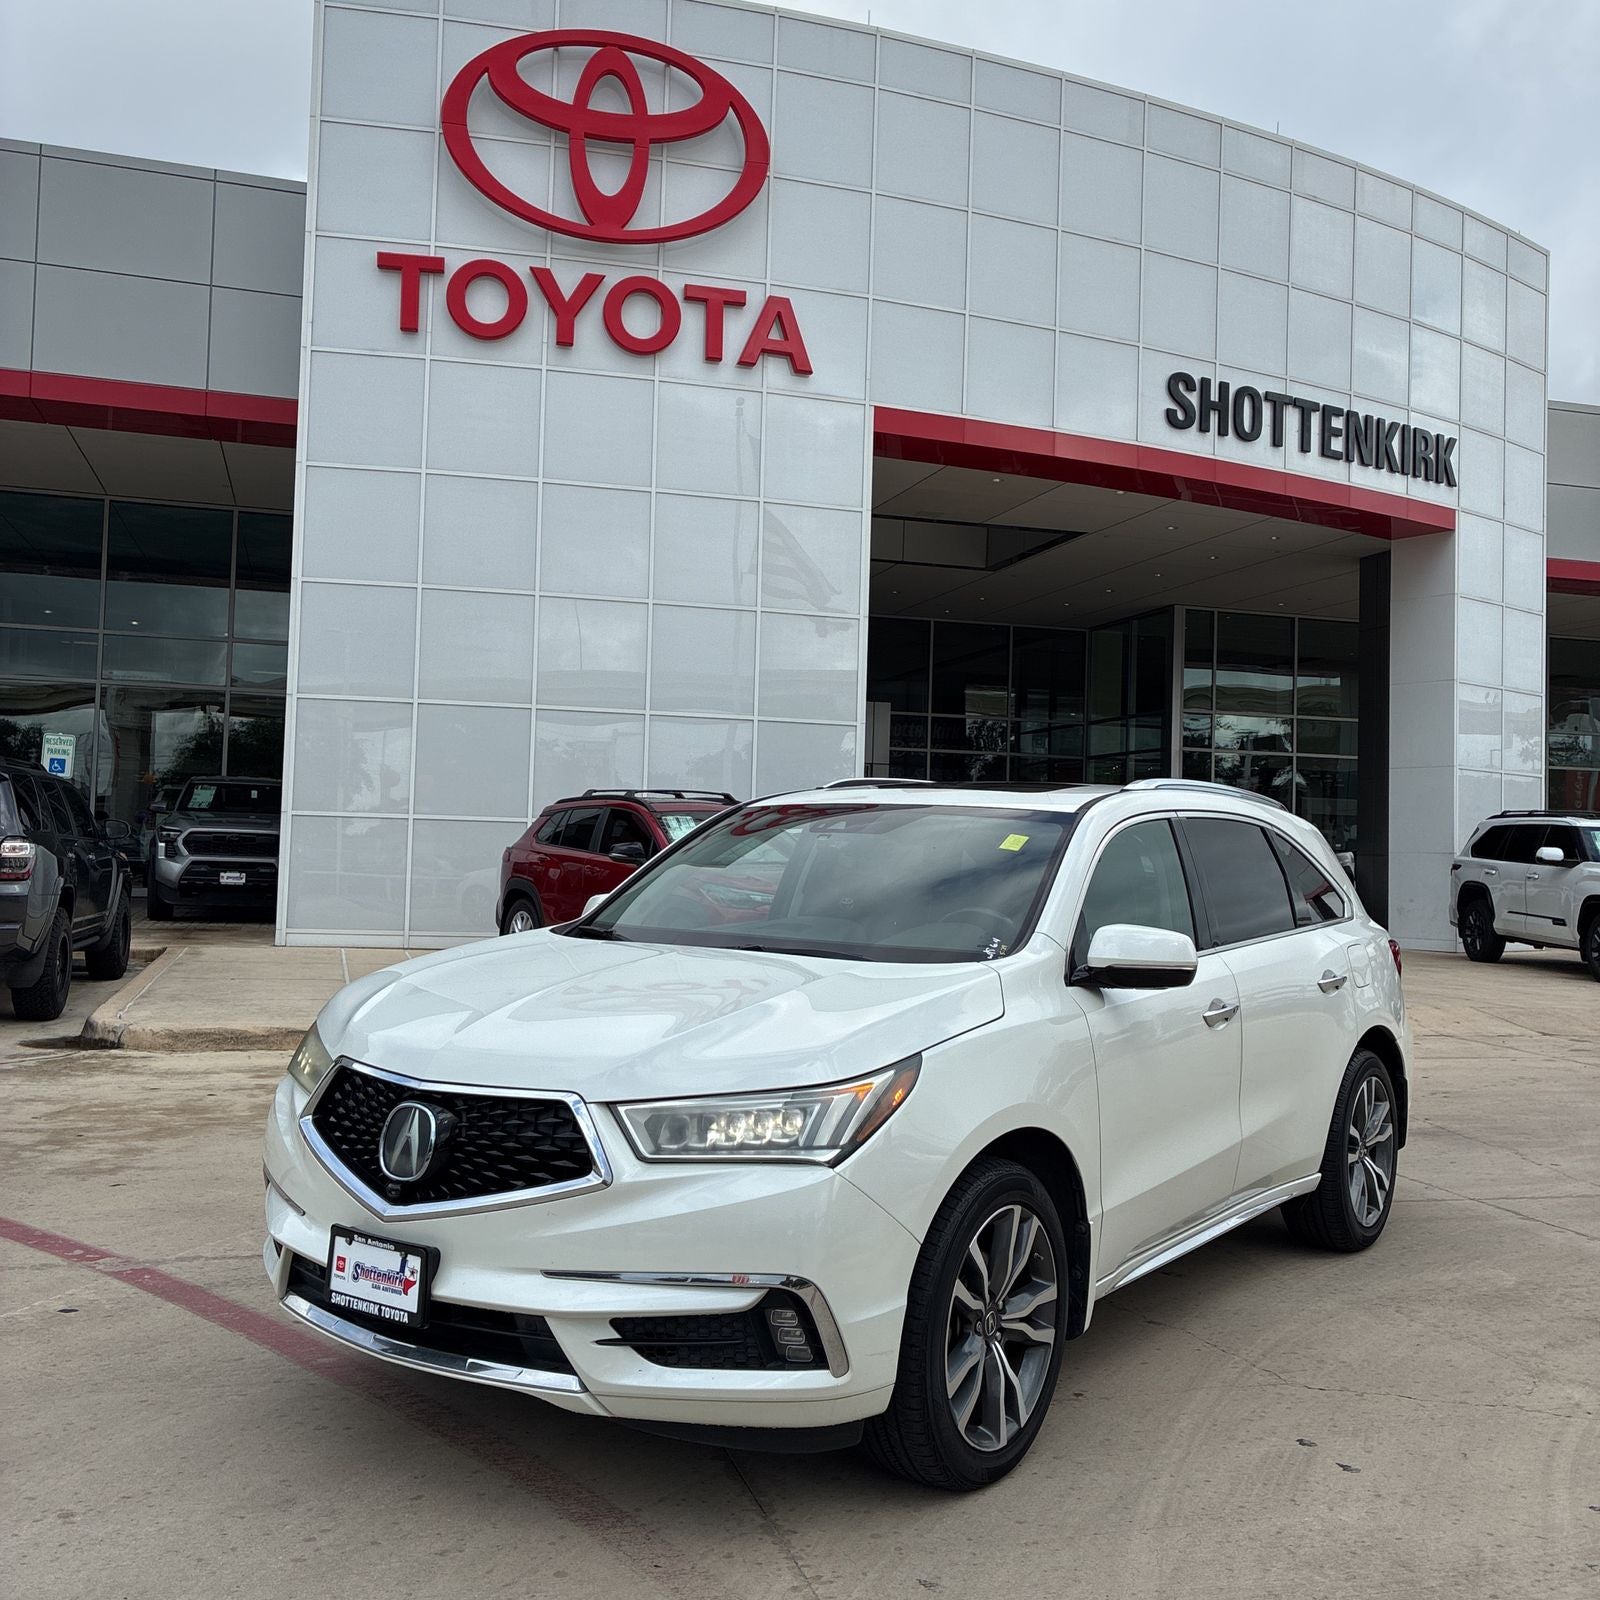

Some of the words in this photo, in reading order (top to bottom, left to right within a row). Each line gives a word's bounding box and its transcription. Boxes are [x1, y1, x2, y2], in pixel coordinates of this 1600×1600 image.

[377, 251, 814, 376] TOYOTA
[1165, 371, 1458, 487] SHOTTENKIRK
[46, 737, 73, 746] RESERVED
[47, 748, 70, 756] PARKING
[354, 1234, 366, 1243] San
[367, 1239, 395, 1250] Antonio
[353, 1261, 404, 1287] Shottenkirk
[382, 1286, 402, 1296] ANTONIO
[331, 1292, 379, 1316] SHOTTENKIRK
[381, 1306, 408, 1323] TOYOTA
